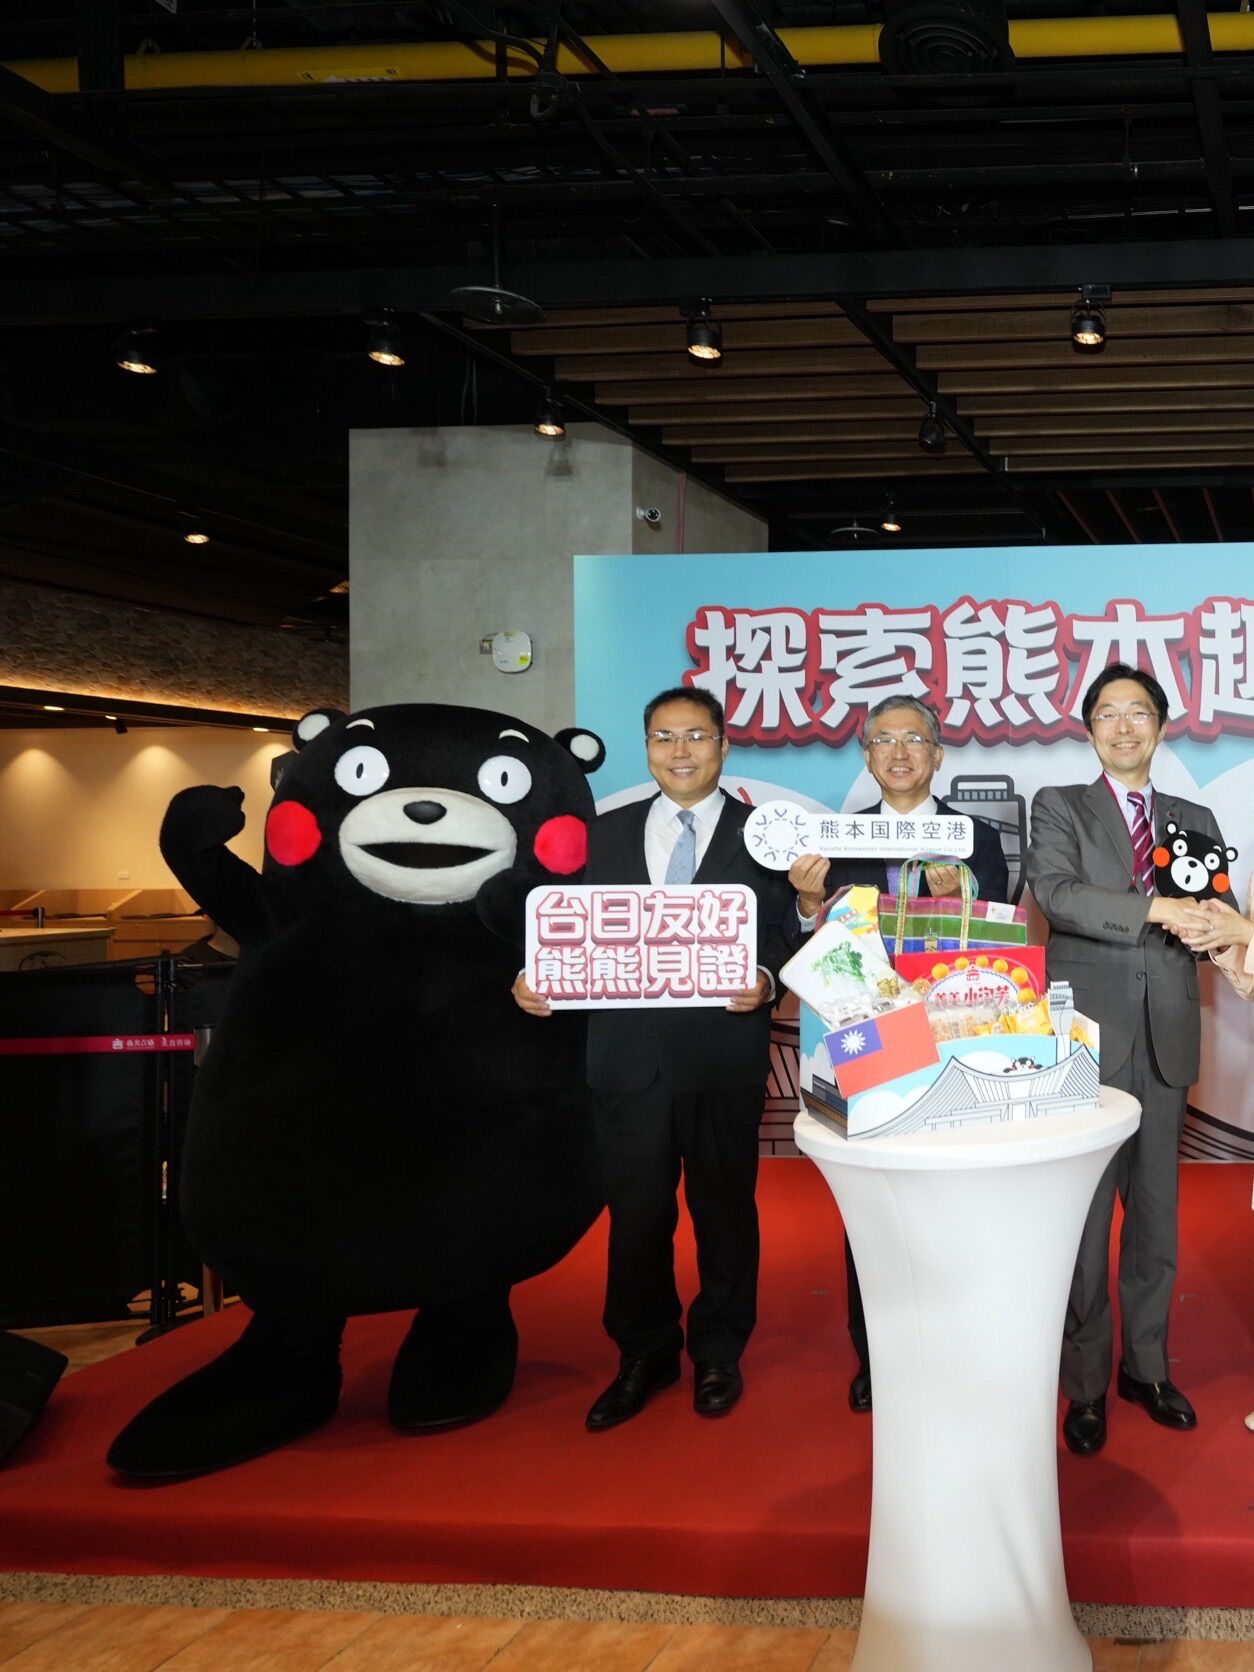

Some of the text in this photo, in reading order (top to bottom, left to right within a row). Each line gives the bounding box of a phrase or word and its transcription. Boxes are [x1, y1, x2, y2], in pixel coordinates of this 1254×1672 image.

[819, 819, 967, 841] 熊本国際空港
[537, 891, 748, 944] 台日友好
[536, 945, 748, 998] 熊熊見證
